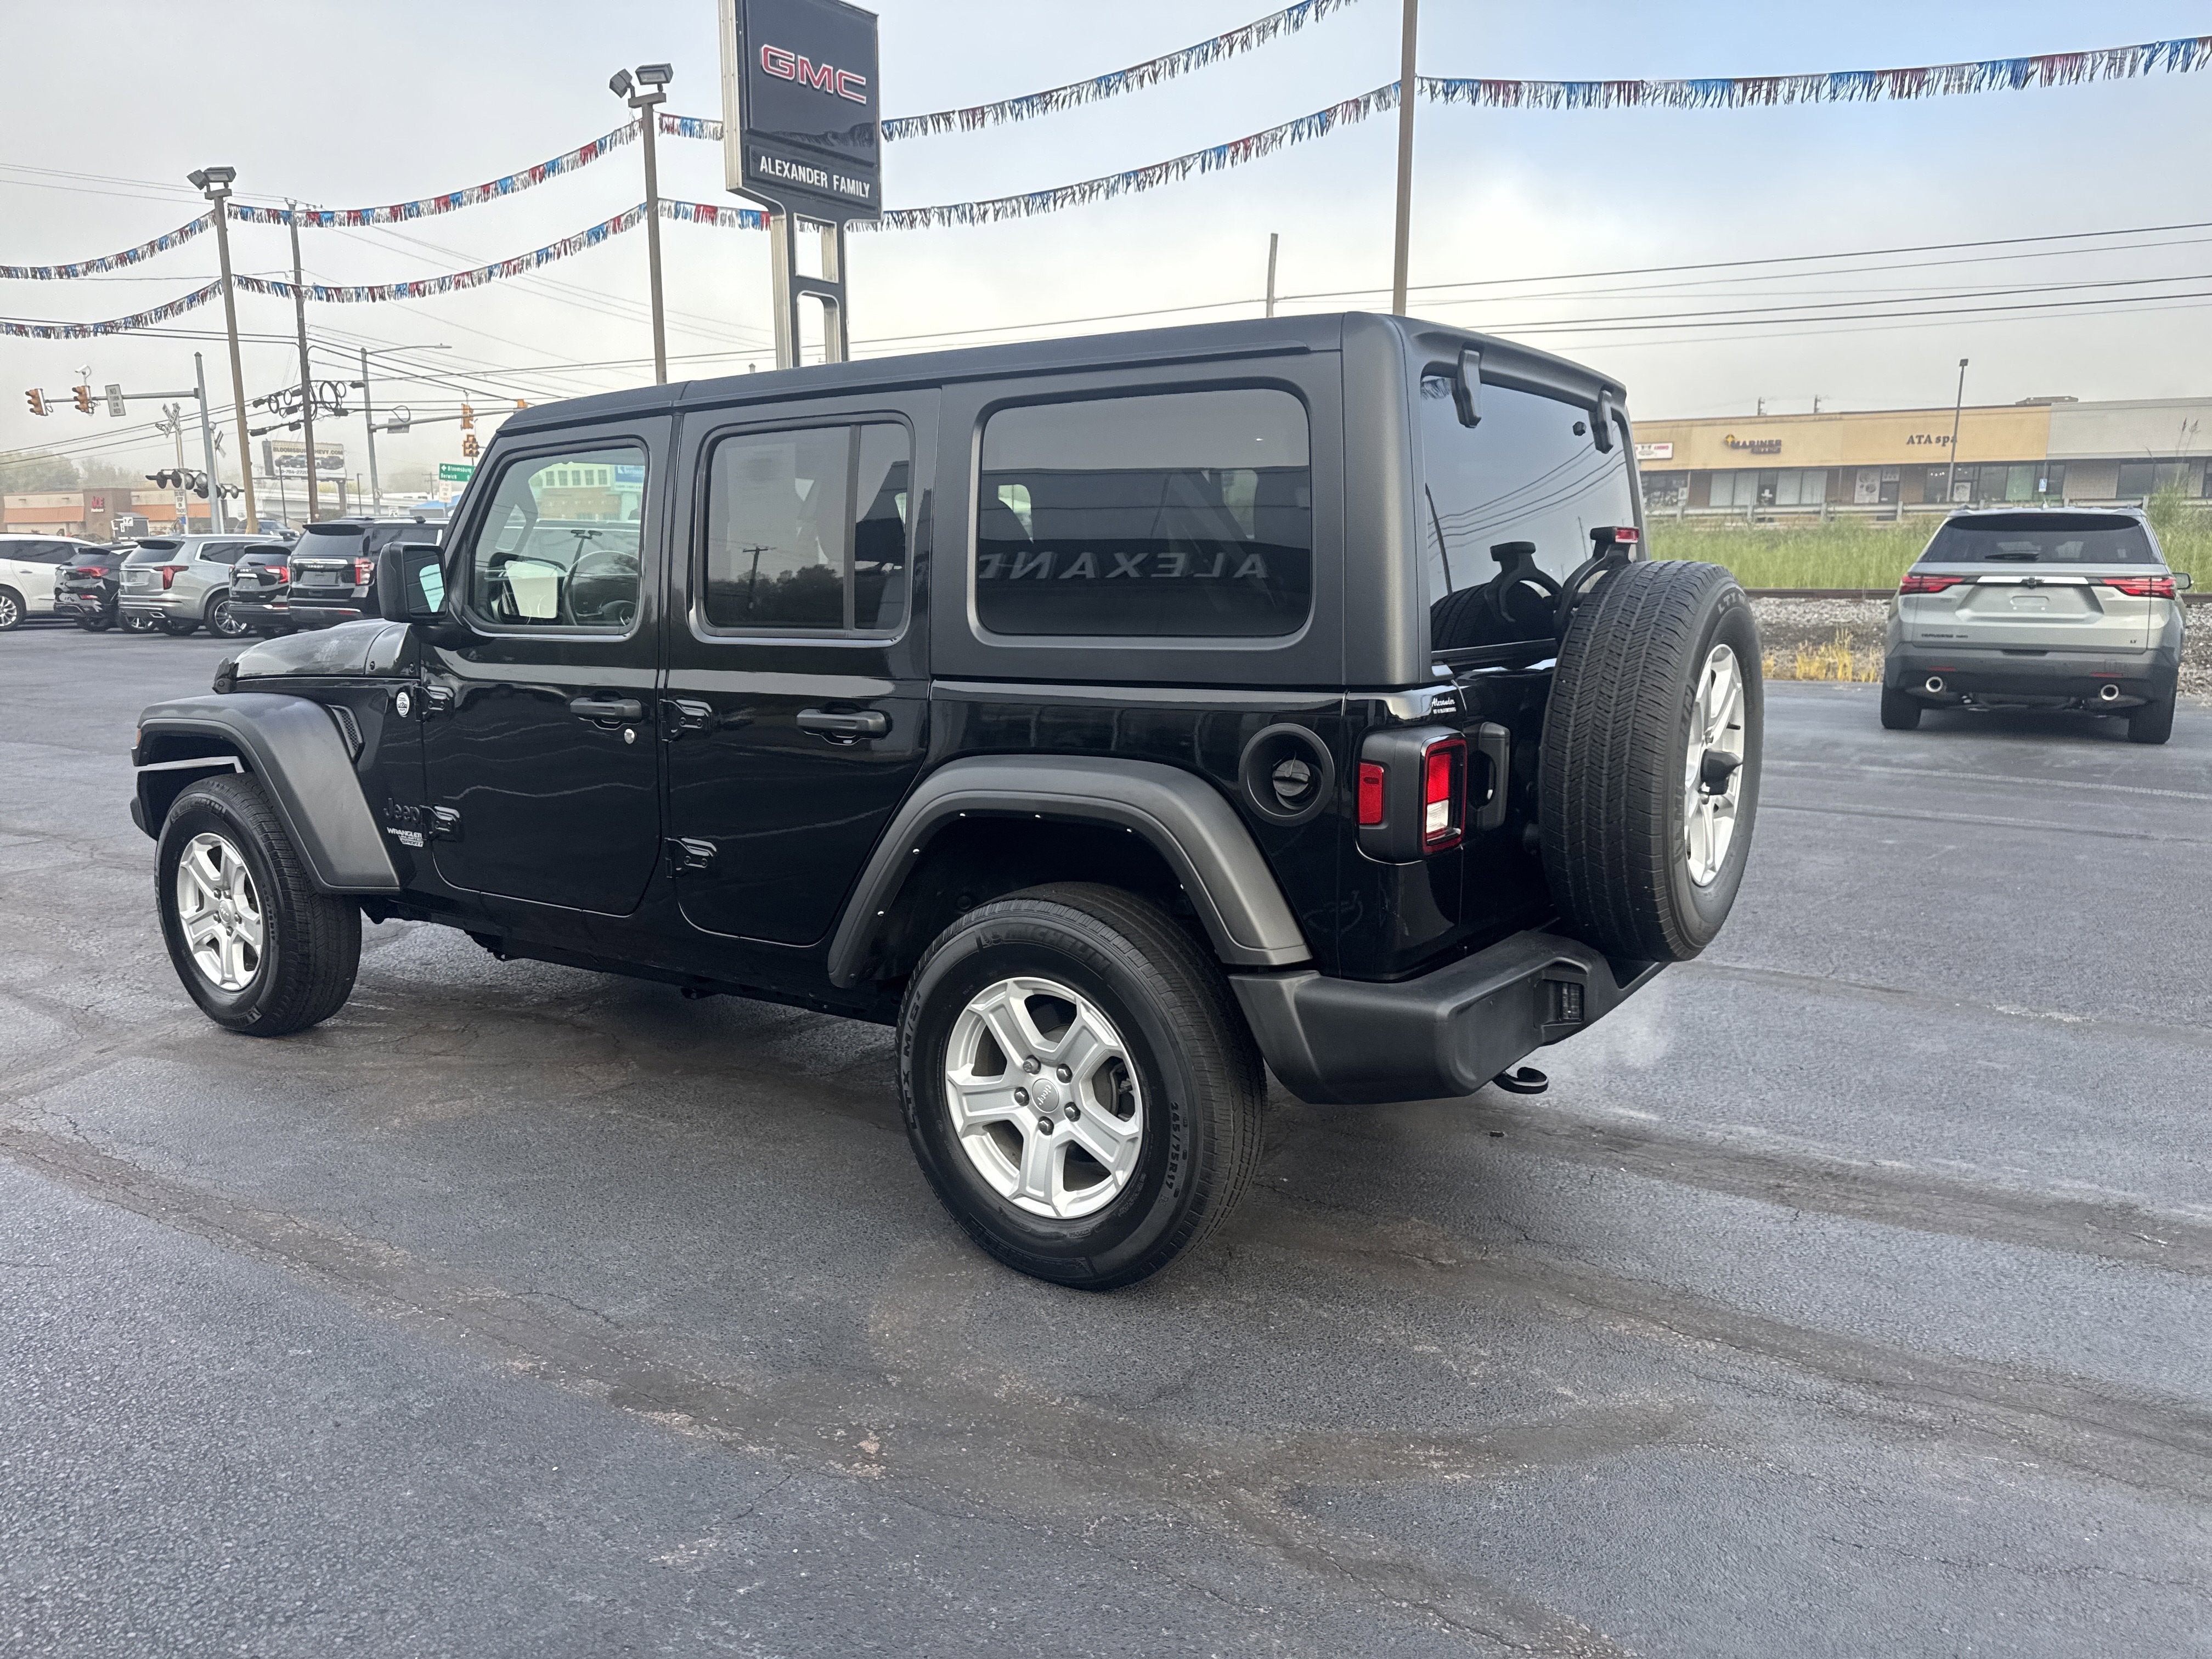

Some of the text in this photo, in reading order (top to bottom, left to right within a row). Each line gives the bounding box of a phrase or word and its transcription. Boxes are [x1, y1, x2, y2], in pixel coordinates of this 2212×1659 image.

[761, 43, 867, 104] GMC
[760, 156, 870, 199] ALEXANDER FAMILY
[1731, 439, 1781, 449] MARINER
[1906, 435, 1932, 445] ATA
[383, 798, 420, 824] Jeep
[387, 827, 422, 839] WRANGLER
[1165, 1101, 1181, 1190] 245/75R17
